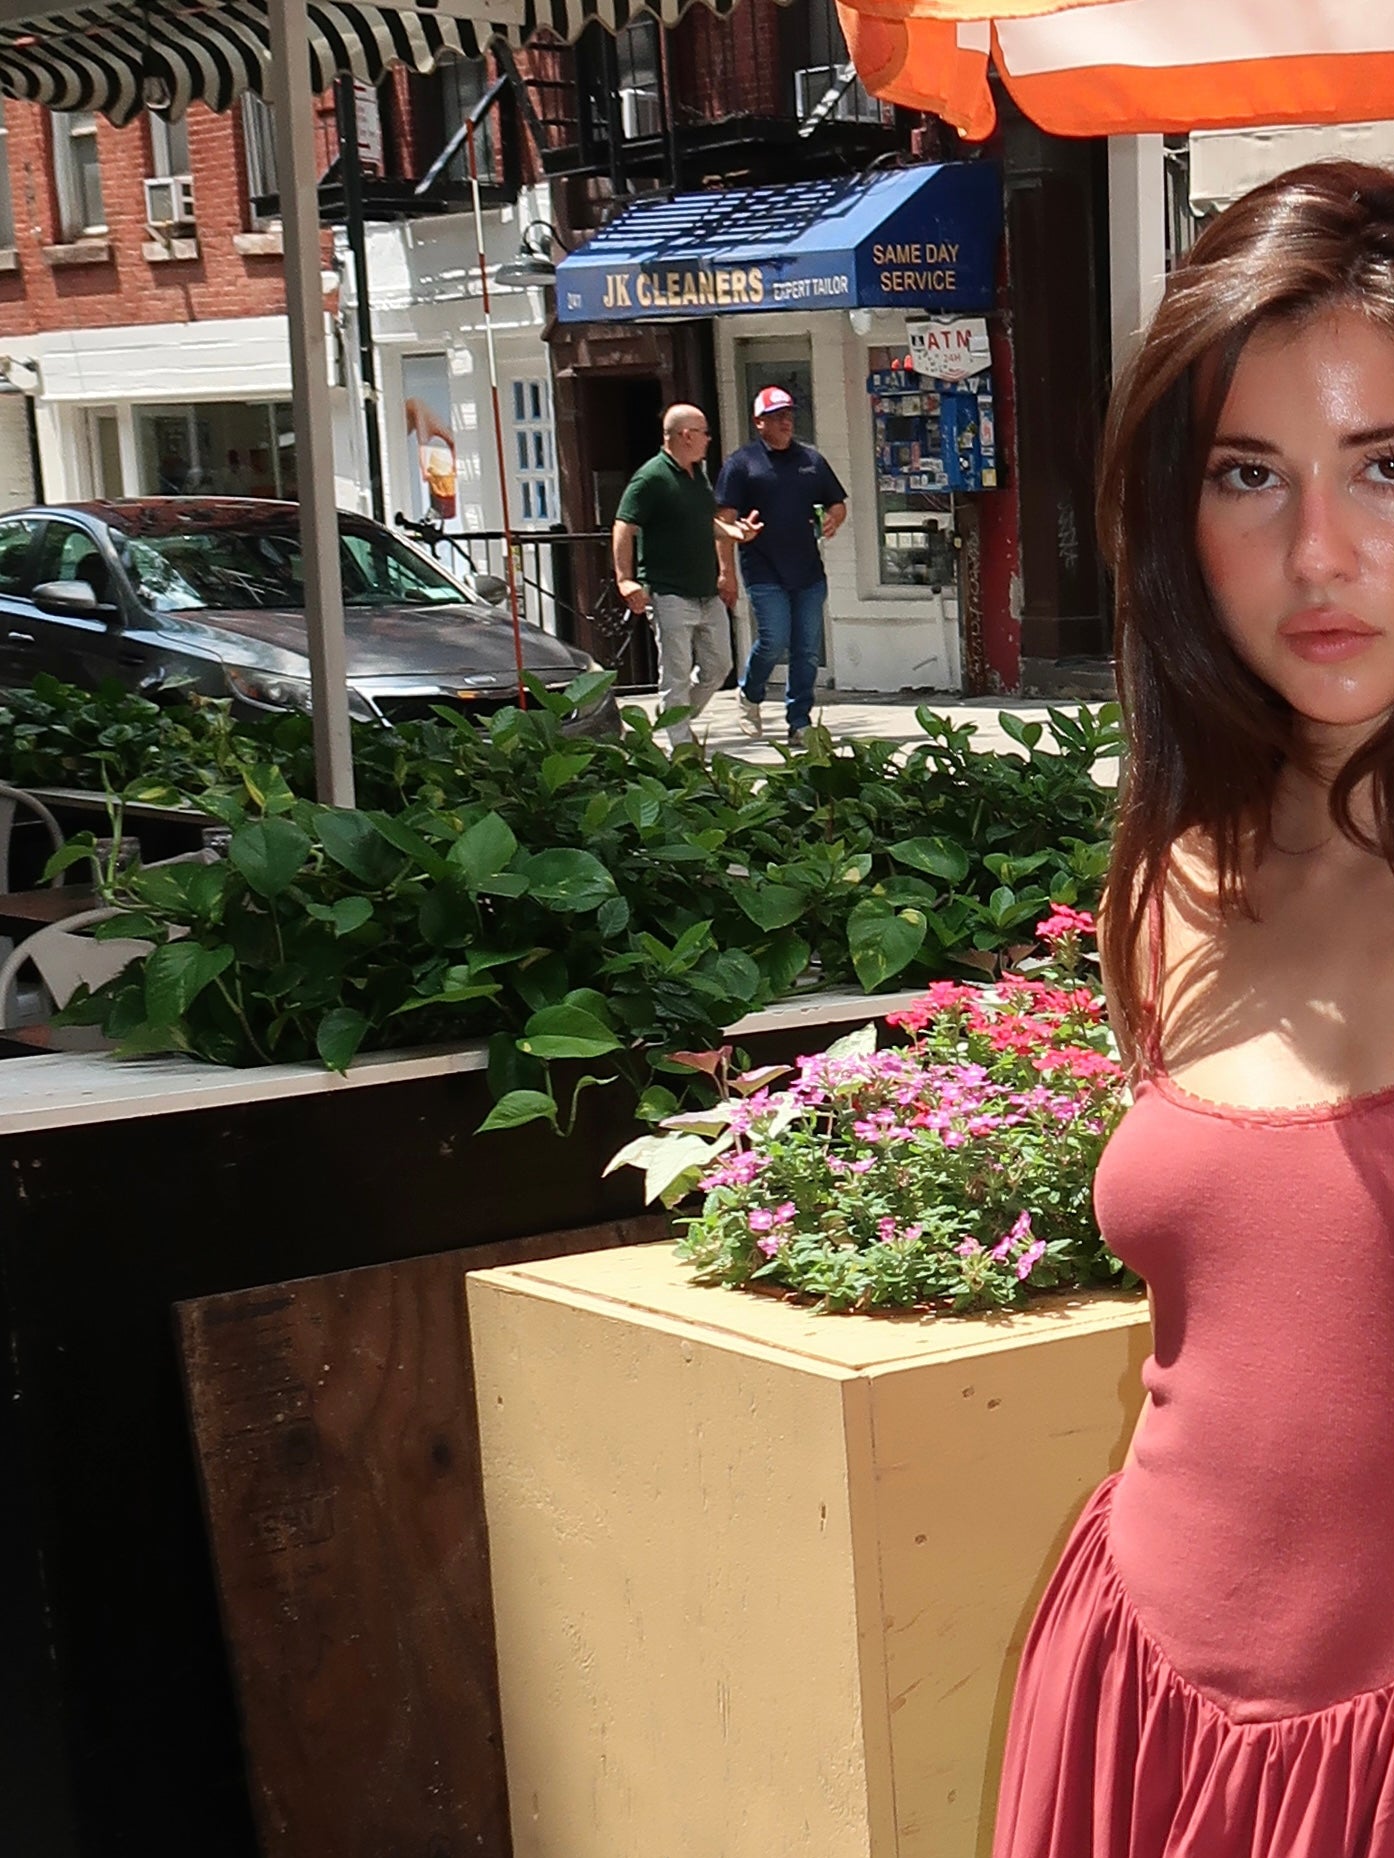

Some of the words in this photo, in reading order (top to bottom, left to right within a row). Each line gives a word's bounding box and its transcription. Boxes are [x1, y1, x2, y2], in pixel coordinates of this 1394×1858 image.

[873, 243, 922, 264] SAME
[925, 243, 960, 263] DAY
[602, 273, 633, 308] JK
[635, 267, 765, 308] CLEANERS
[772, 279, 811, 301] EXPERT
[813, 275, 849, 296] TAILOR
[880, 270, 957, 291] SERVICE
[927, 329, 972, 351] ATM
